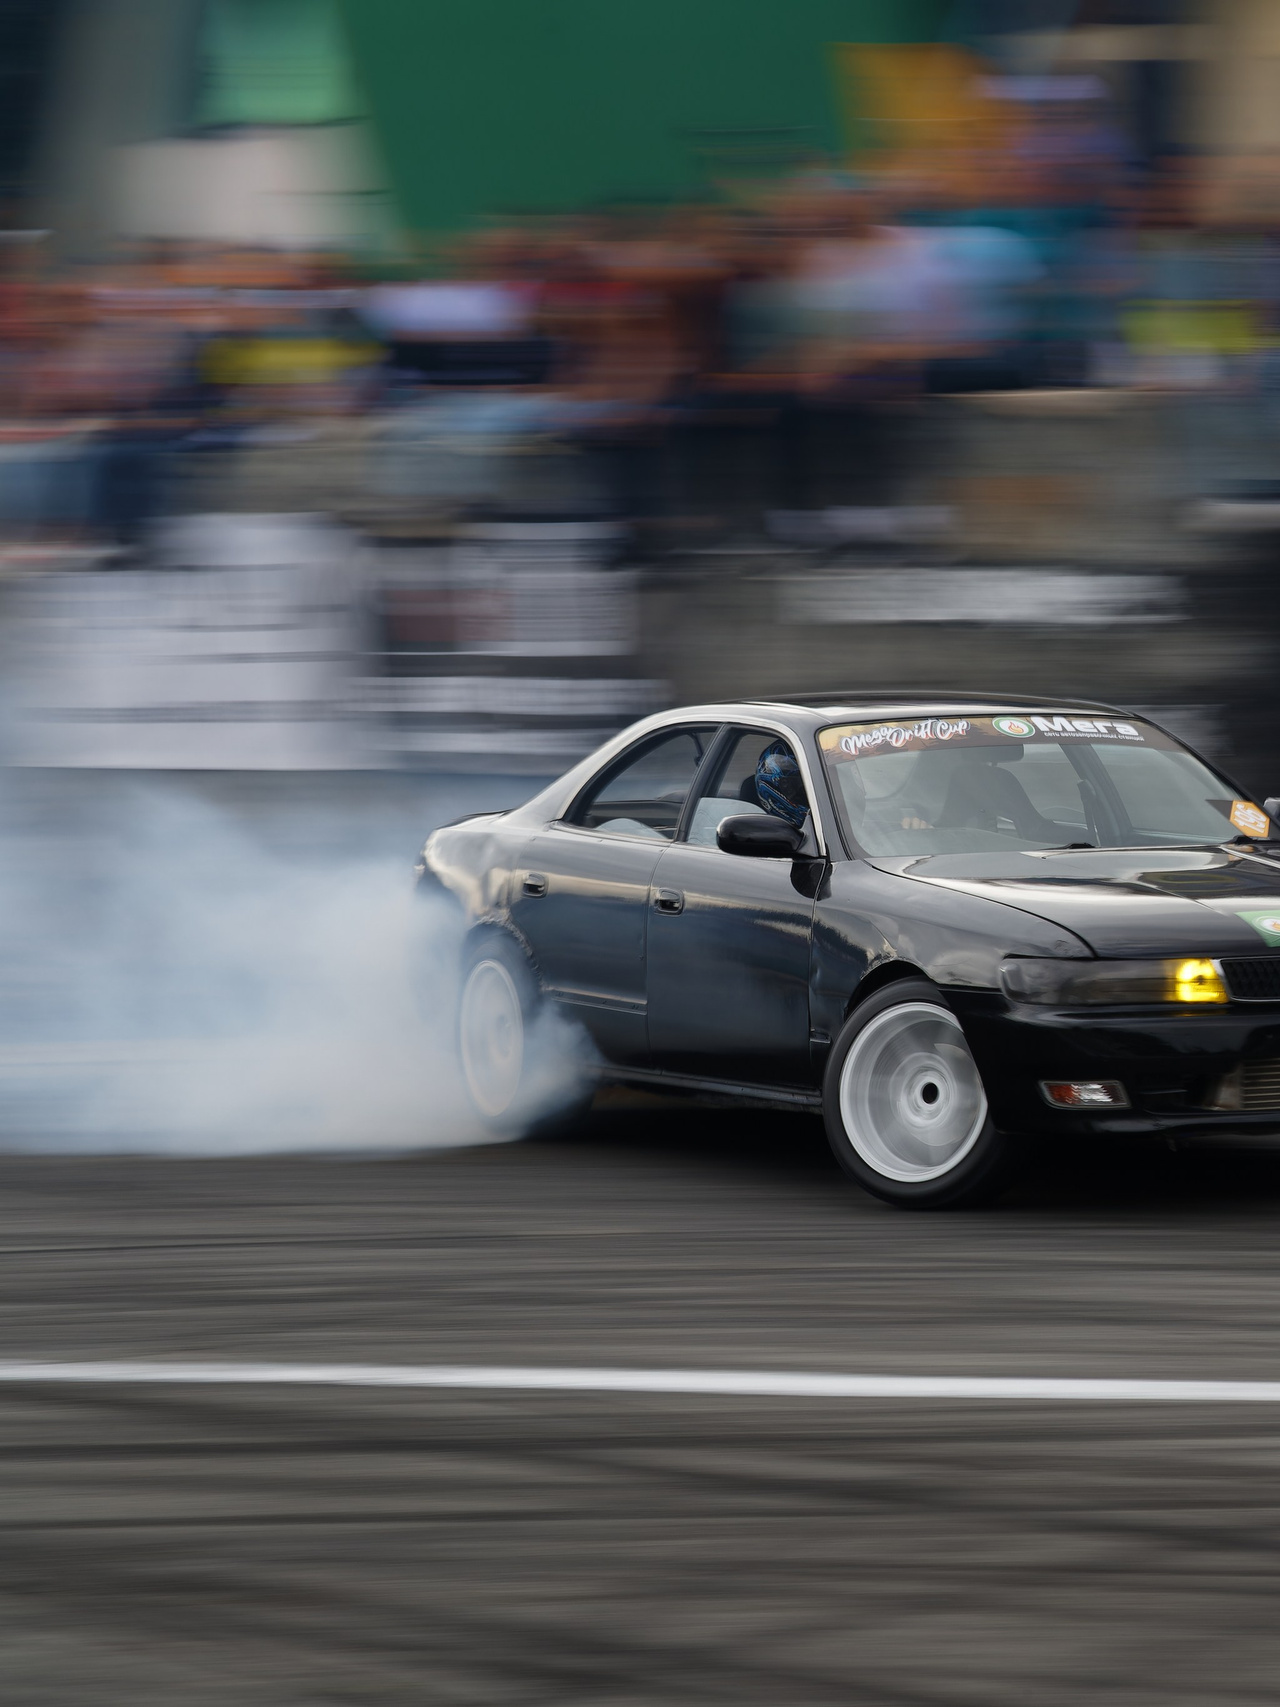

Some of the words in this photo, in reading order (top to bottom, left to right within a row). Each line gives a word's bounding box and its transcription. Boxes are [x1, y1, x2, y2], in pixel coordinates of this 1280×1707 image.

[840, 726, 890, 755] Mega
[886, 719, 940, 747] Drift
[936, 719, 970, 740] Cup
[1030, 716, 1138, 735] Мега
